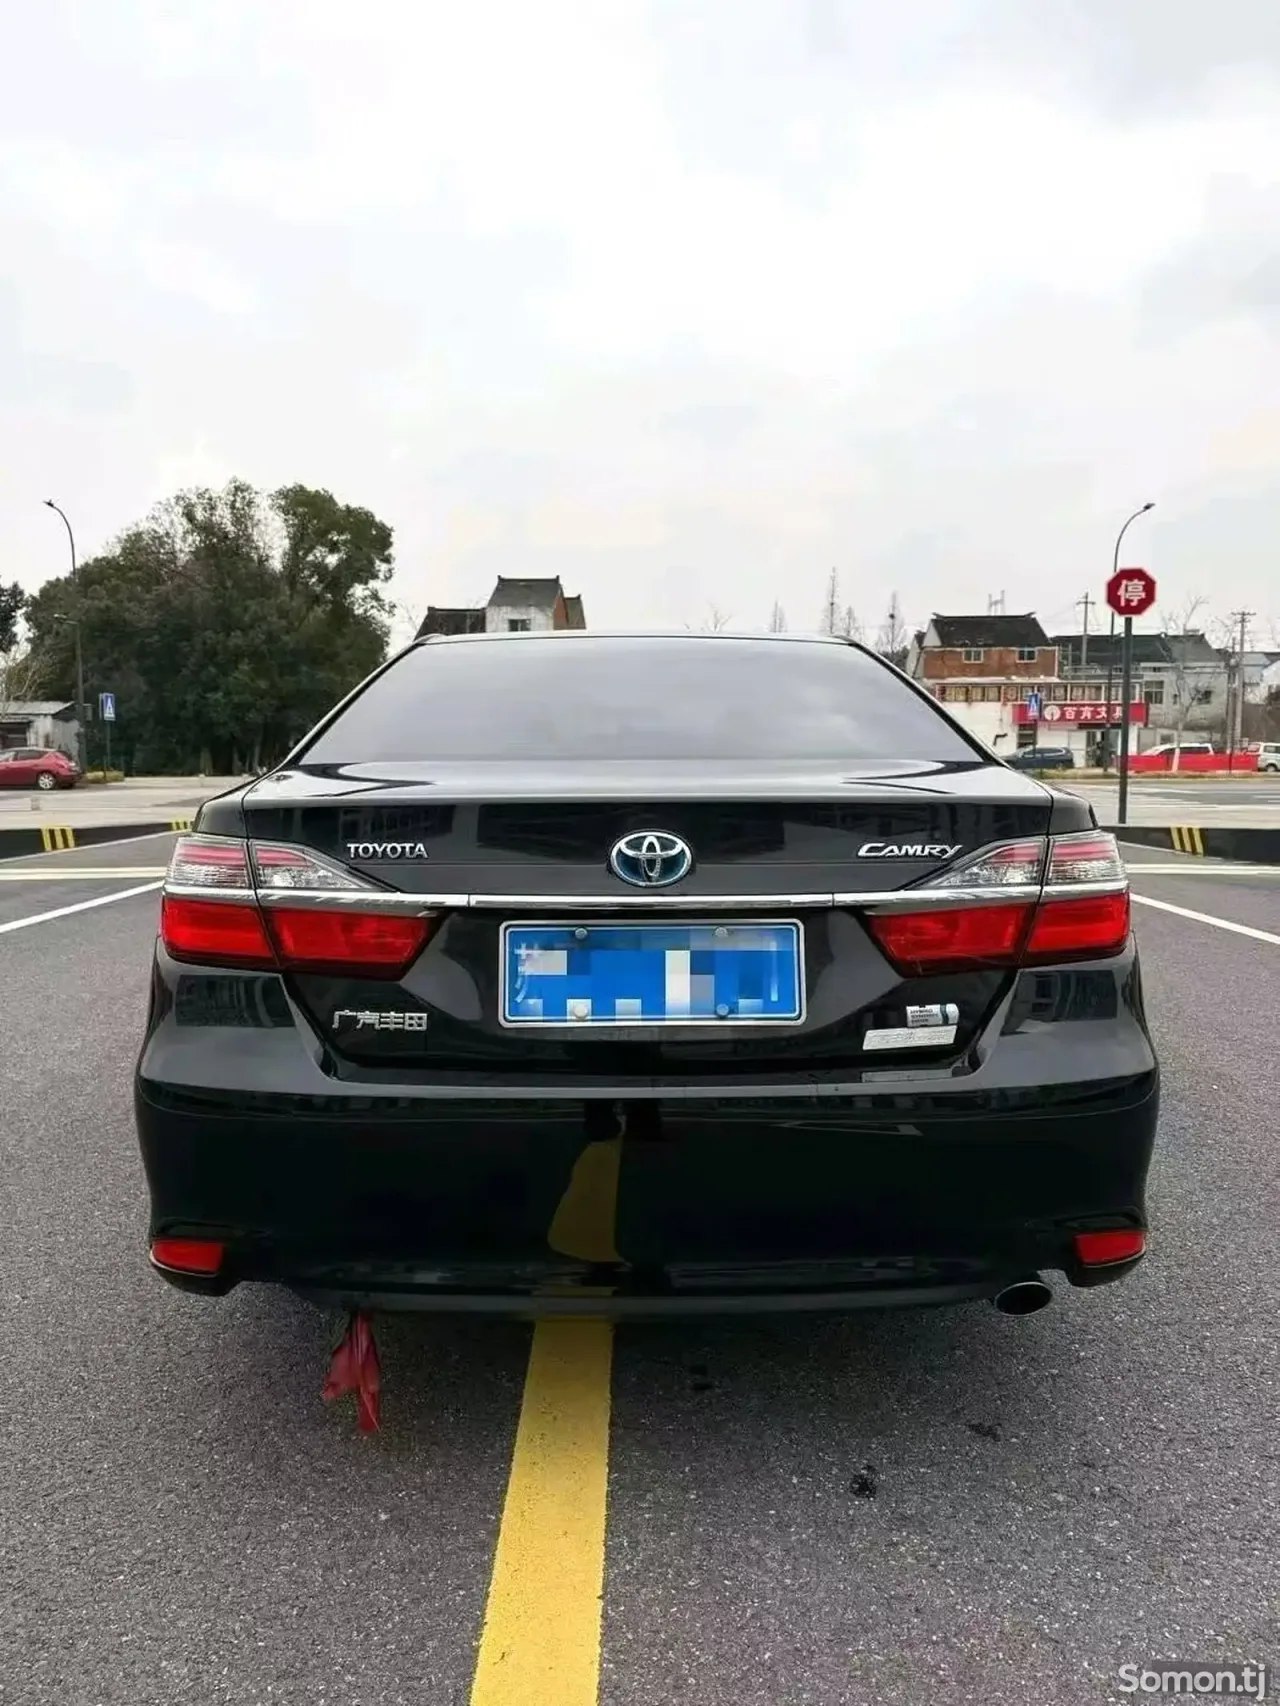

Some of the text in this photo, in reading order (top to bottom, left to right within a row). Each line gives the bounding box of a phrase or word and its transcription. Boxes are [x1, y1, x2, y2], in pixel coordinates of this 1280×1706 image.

[1117, 579, 1146, 607] 停
[346, 842, 428, 859] TOYOTA
[857, 842, 964, 859] CAMRY
[332, 1010, 428, 1031] 广汽丰田
